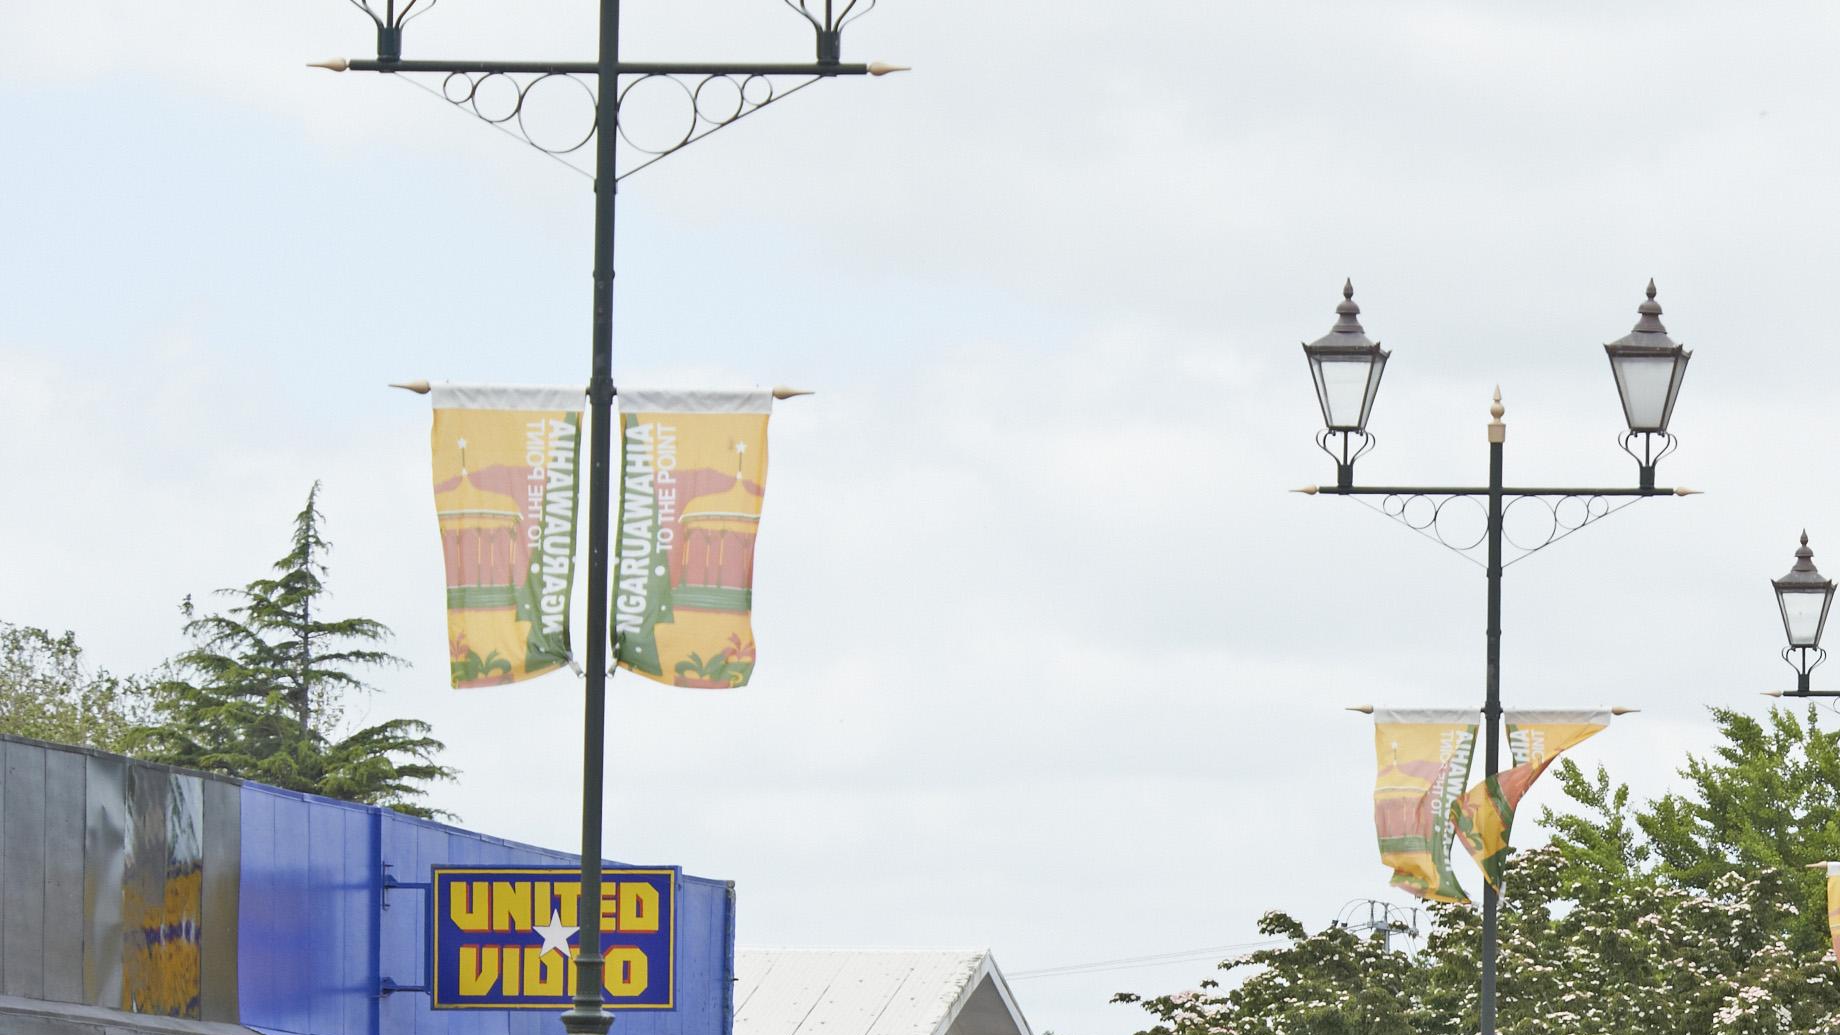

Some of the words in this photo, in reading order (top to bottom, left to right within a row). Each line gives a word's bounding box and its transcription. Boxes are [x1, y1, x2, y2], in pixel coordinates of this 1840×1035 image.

[657, 423, 676, 483] POINT
[616, 423, 653, 633] NGARUAWAHIA
[657, 489, 675, 524] THE
[656, 528, 674, 553] TO
[450, 881, 659, 934] UNITED
